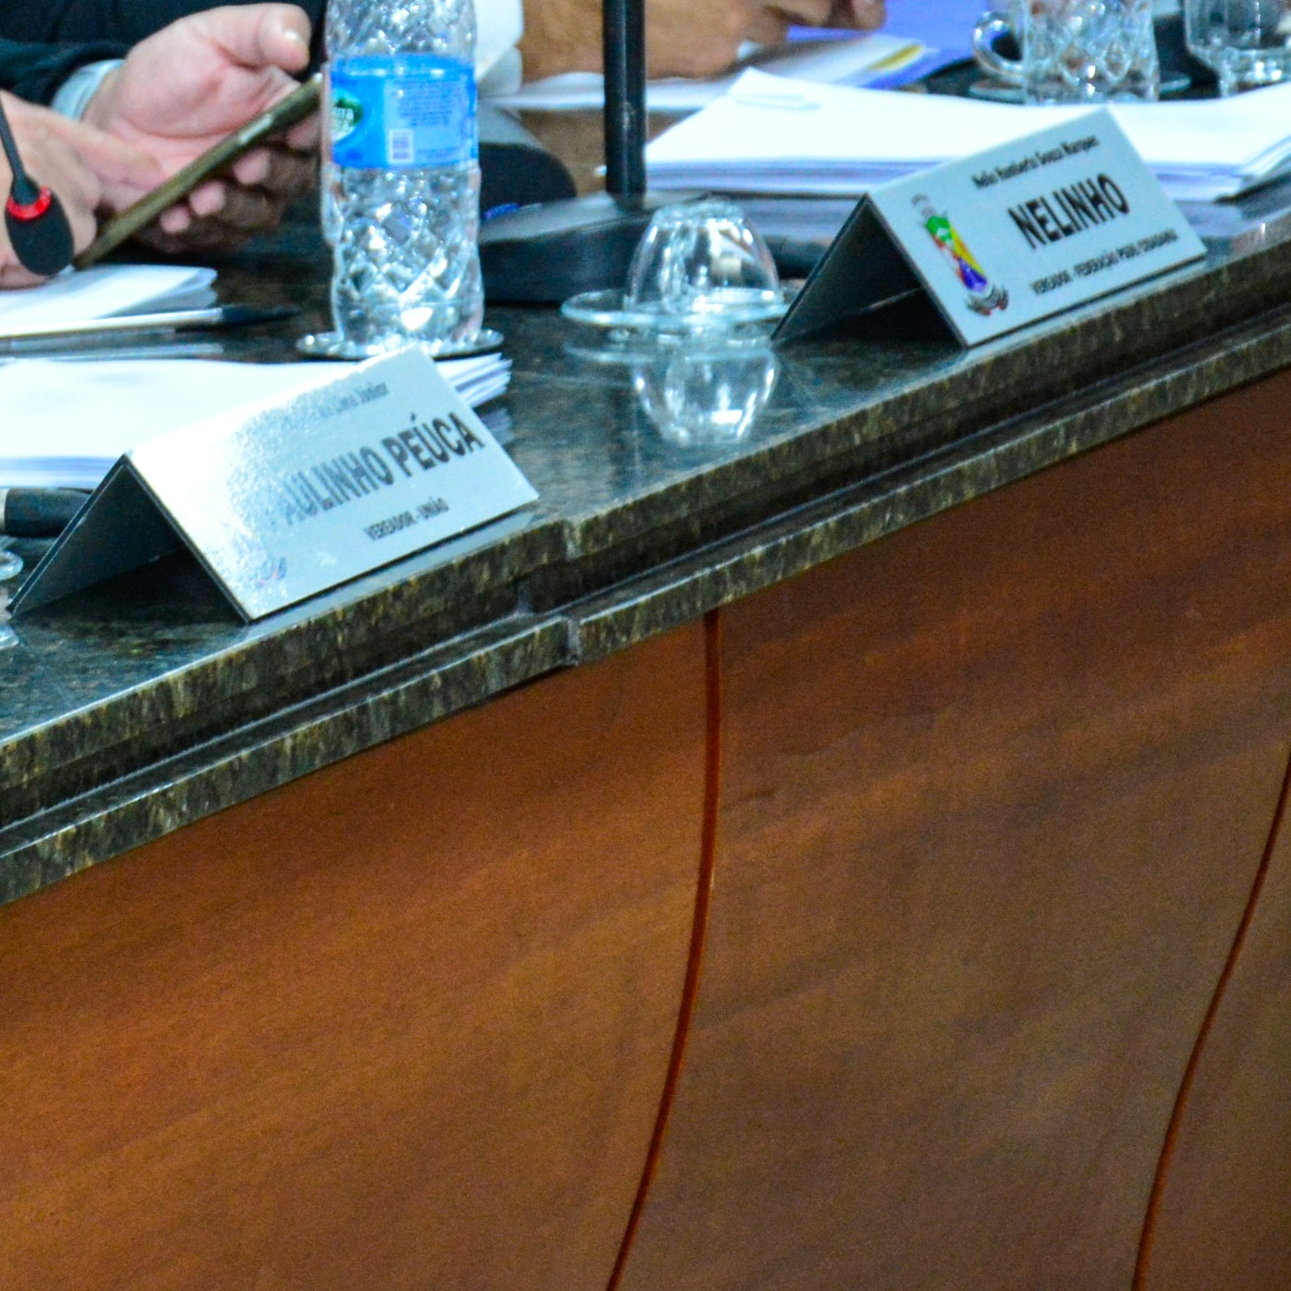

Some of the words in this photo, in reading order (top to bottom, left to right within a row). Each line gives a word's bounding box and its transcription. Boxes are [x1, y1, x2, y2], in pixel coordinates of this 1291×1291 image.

[1008, 173, 1130, 249] NELINHO
[381, 411, 485, 477] PEÚCA
[364, 510, 417, 540] VEREADOR
